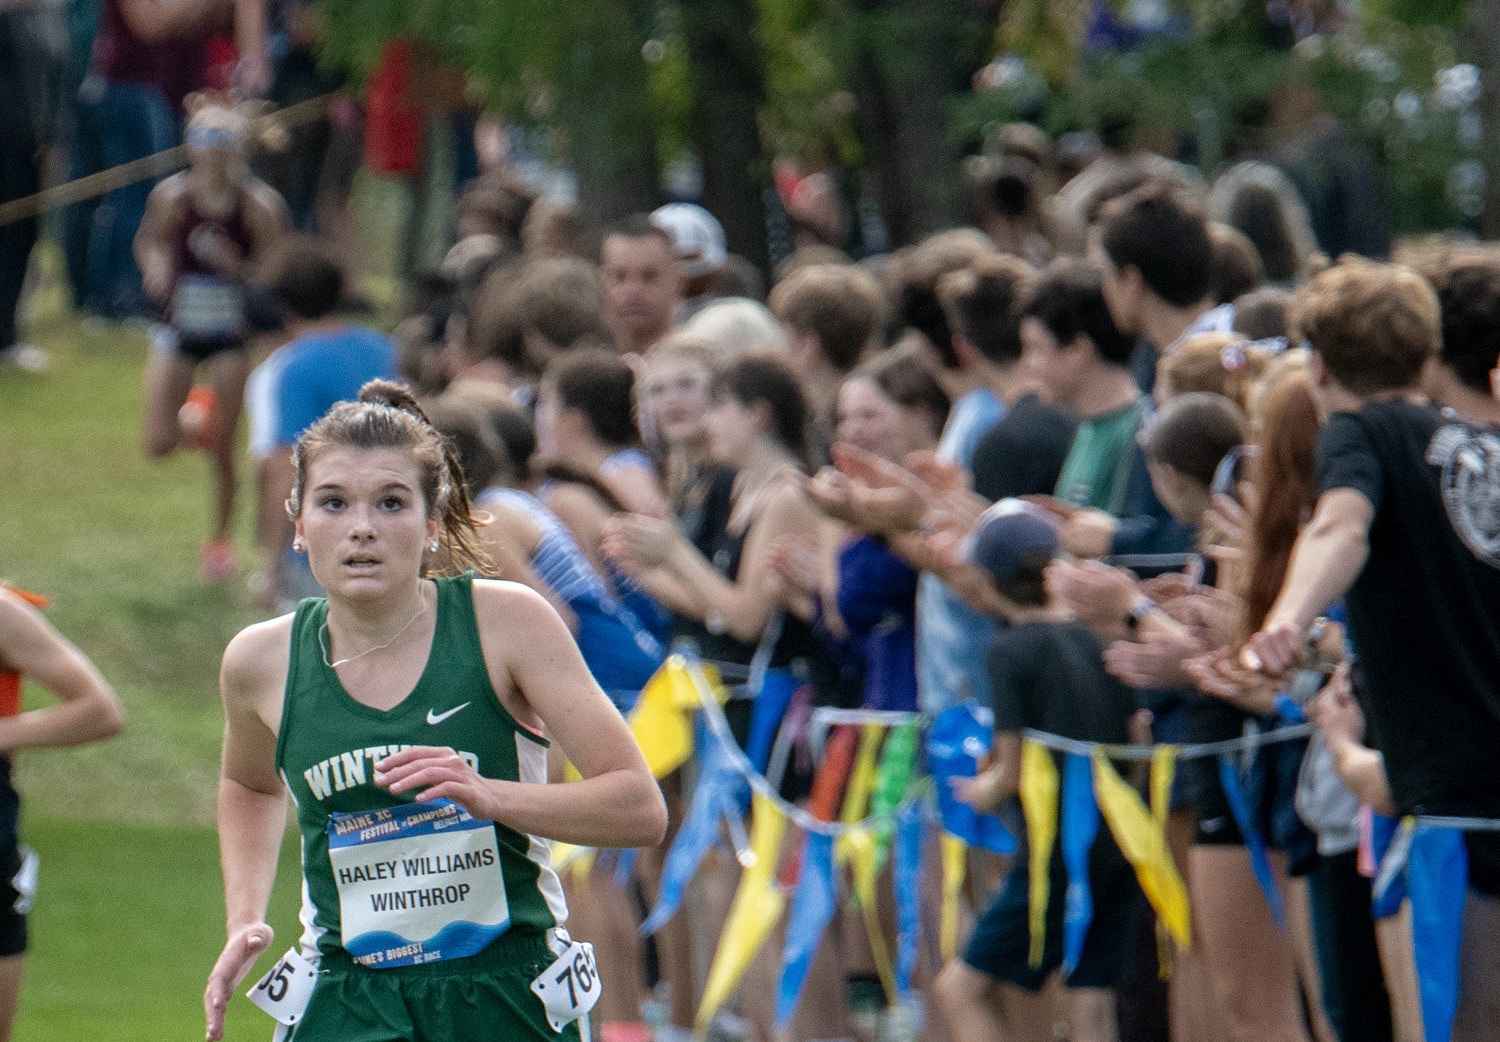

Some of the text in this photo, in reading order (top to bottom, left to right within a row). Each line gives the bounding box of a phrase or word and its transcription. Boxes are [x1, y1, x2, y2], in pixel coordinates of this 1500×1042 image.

[304, 744, 479, 800] WINTP
[335, 815, 374, 835] MAINE
[375, 809, 392, 822] XC
[360, 820, 399, 841] FESTIVAL
[407, 804, 457, 826] CHAMPIONS
[338, 849, 494, 885] HALEY WILLIAMS
[371, 883, 470, 912] WINTHROP
[386, 943, 424, 960] BIGGEST
